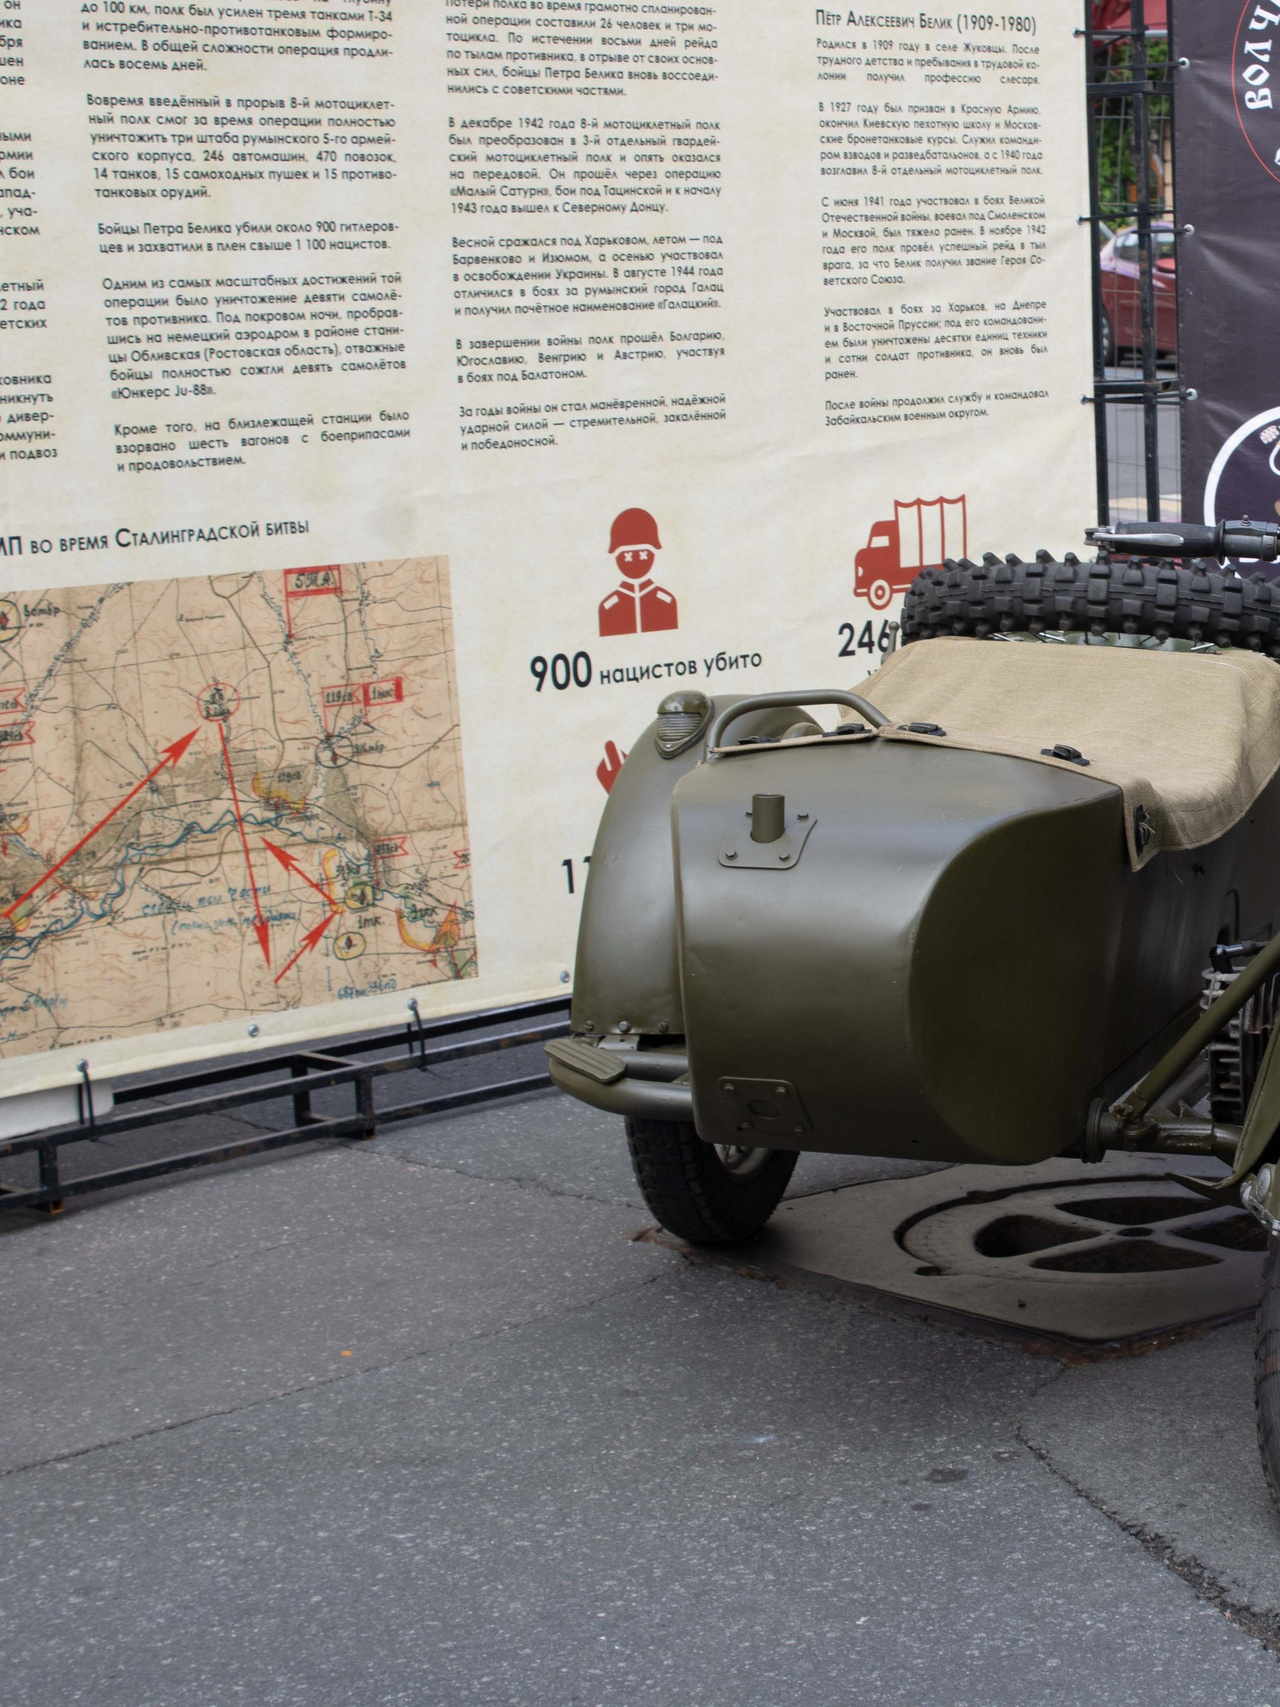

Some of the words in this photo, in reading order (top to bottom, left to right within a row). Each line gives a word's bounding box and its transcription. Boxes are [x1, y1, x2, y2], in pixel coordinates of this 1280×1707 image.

[80, 2, 99, 14] до
[102, 0, 126, 14] 100
[154, 5, 186, 16] полк
[187, 3, 215, 17] был
[216, 7, 264, 20] усилен
[266, 9, 307, 22] тремя
[309, 10, 365, 22] танками
[367, 9, 393, 23] Т-34
[445, 15, 468, 25] ной
[471, 15, 532, 29] операции
[535, 17, 597, 29] составили
[599, 17, 613, 30] 26
[615, 20, 662, 31] человек
[674, 22, 695, 34] три
[697, 23, 718, 33] мо-
[956, 13, 1037, 35] (1909-1980)
[816, 37, 857, 50] Родился
[872, 39, 894, 51] 1909
[898, 42, 921, 54] году
[935, 43, 959, 53] селе
[1011, 43, 1040, 55] После
[85, 93, 145, 109] Вовремя
[148, 94, 221, 109] введённый
[236, 98, 286, 111] прорыв
[289, 96, 311, 109] 8-й
[314, 99, 395, 111] мотоциклет-
[830, 101, 852, 113] 1927
[856, 104, 879, 115] году
[883, 101, 904, 113] был
[907, 104, 946, 116] призван
[960, 103, 1003, 116] Красную
[459, 116, 513, 131] декабре
[518, 117, 545, 129] 1942
[548, 119, 576, 130] года
[579, 117, 599, 130] 8-й
[602, 118, 692, 131] мотоциклетный
[695, 121, 721, 131] полк
[91, 151, 130, 162] ского
[202, 149, 225, 162] 246
[315, 149, 338, 163] 470
[8, 166, 36, 180] бои
[451, 201, 478, 214] 1943
[479, 204, 508, 215] года
[510, 204, 551, 214] вышел
[561, 201, 628, 216] Северному
[833, 198, 859, 208] июня
[863, 195, 884, 207] 1941
[889, 197, 912, 208] года
[915, 197, 971, 209] участвовал
[983, 194, 1005, 206] боях
[1008, 194, 1046, 205] Великой
[7, 206, 38, 220] уча-
[97, 222, 141, 236] Бойцы
[143, 222, 184, 237] Петра
[186, 221, 232, 235] Белика
[234, 221, 273, 237] убили
[275, 223, 313, 234] около
[315, 220, 337, 233] 900
[339, 222, 400, 235] гитлеров-
[451, 235, 496, 249] Весной
[497, 237, 557, 250] сражался
[559, 237, 583, 248] под
[652, 235, 687, 245] летом
[702, 234, 724, 245] под
[101, 277, 148, 291] Одним
[150, 279, 166, 289] из
[168, 278, 213, 289] самых
[215, 274, 299, 288] масштабных
[301, 271, 378, 287] достижений
[379, 271, 402, 284] той
[13, 299, 46, 311] года
[824, 399, 856, 411] После
[858, 397, 890, 409] войны
[891, 396, 946, 409] продолжил
[947, 391, 983, 405] службу
[993, 390, 1050, 401] командовал
[6, 411, 55, 424] дивер-
[115, 441, 177, 456] взорвано
[188, 438, 229, 450] шесть
[240, 435, 290, 448] вагонов
[320, 428, 411, 444] боеприпасами
[9, 448, 58, 461] подвоз
[838, 618, 891, 657] 246
[530, 650, 593, 693] 900
[599, 658, 697, 685] нацистов
[703, 651, 763, 678] убито
